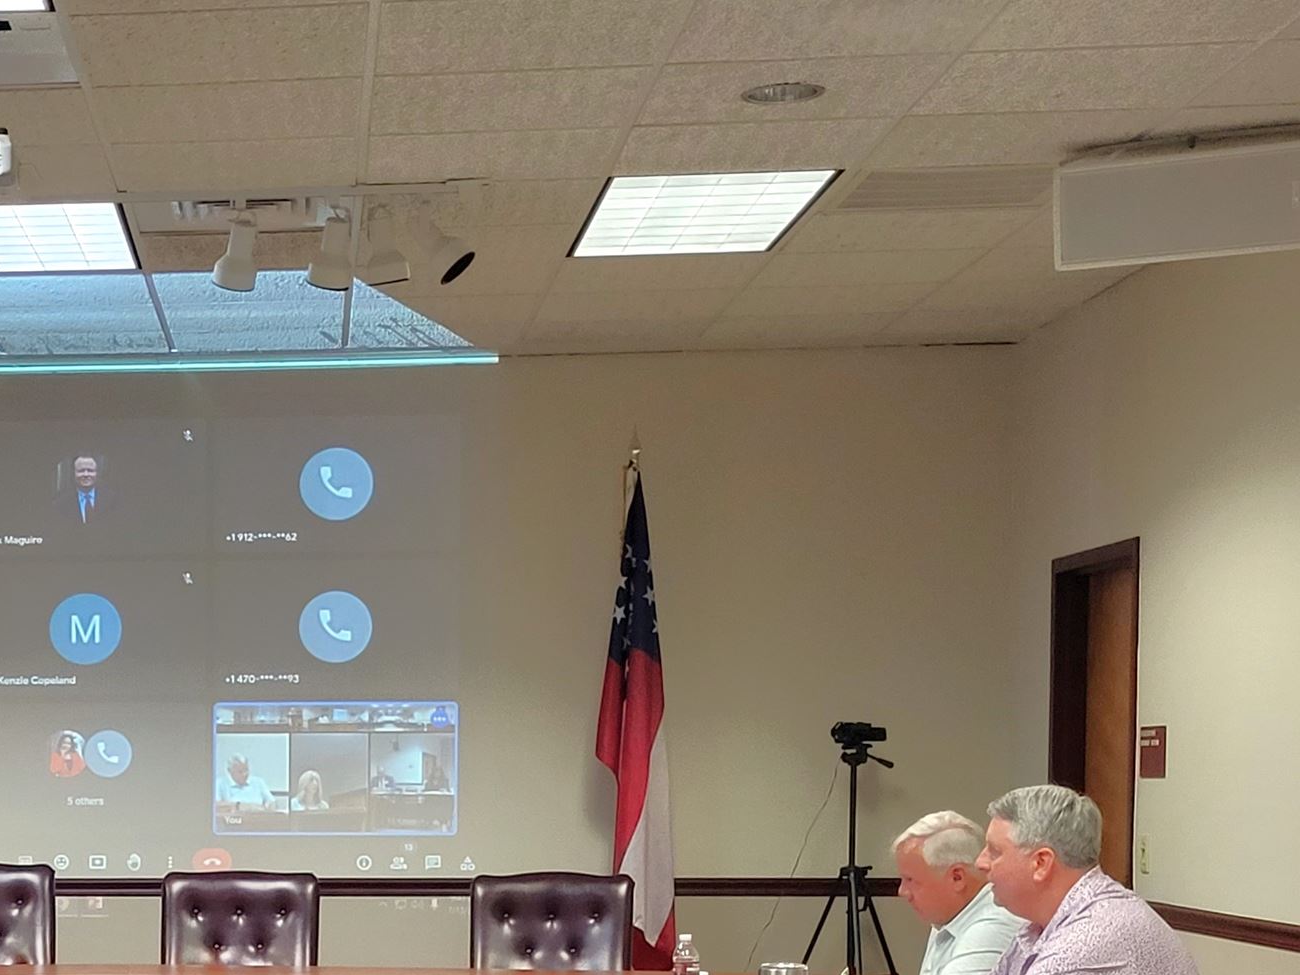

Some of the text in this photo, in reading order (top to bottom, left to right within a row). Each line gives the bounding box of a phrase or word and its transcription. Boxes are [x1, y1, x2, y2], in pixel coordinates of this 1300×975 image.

[4, 535, 44, 546] Maguire
[70, 614, 101, 644] M
[30, 675, 76, 687] Copeland
[224, 815, 242, 825] You
